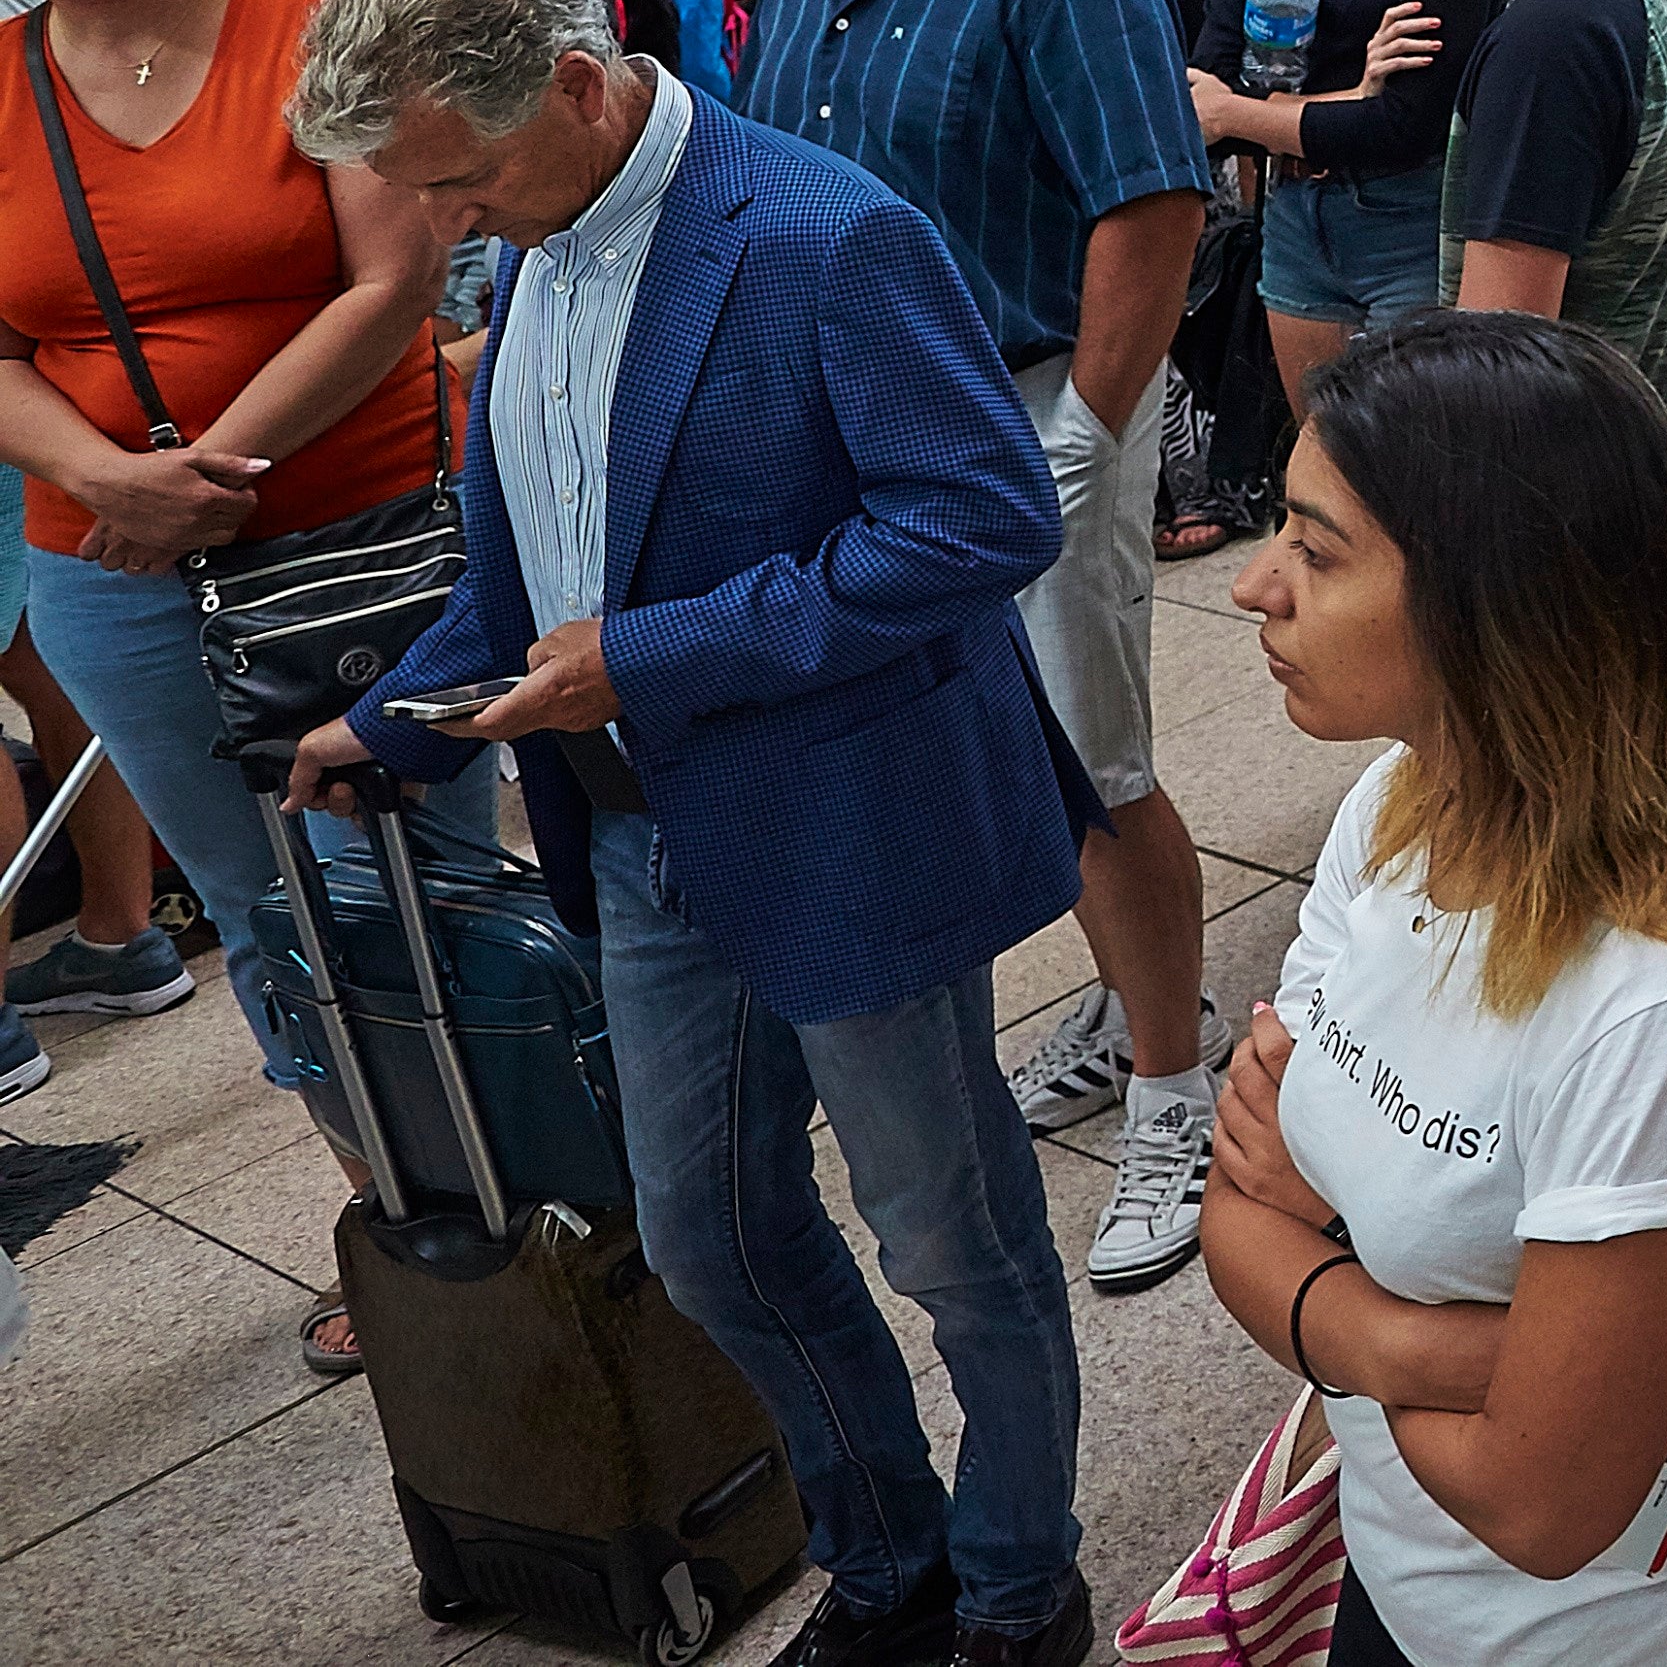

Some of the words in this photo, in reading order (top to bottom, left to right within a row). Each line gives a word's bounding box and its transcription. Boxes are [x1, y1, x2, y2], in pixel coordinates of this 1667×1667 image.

[1307, 988, 1327, 1031] ew
[1319, 1020, 1367, 1084] shirt.
[1370, 1059, 1421, 1135] Who
[1422, 1110, 1501, 1163] dis?
